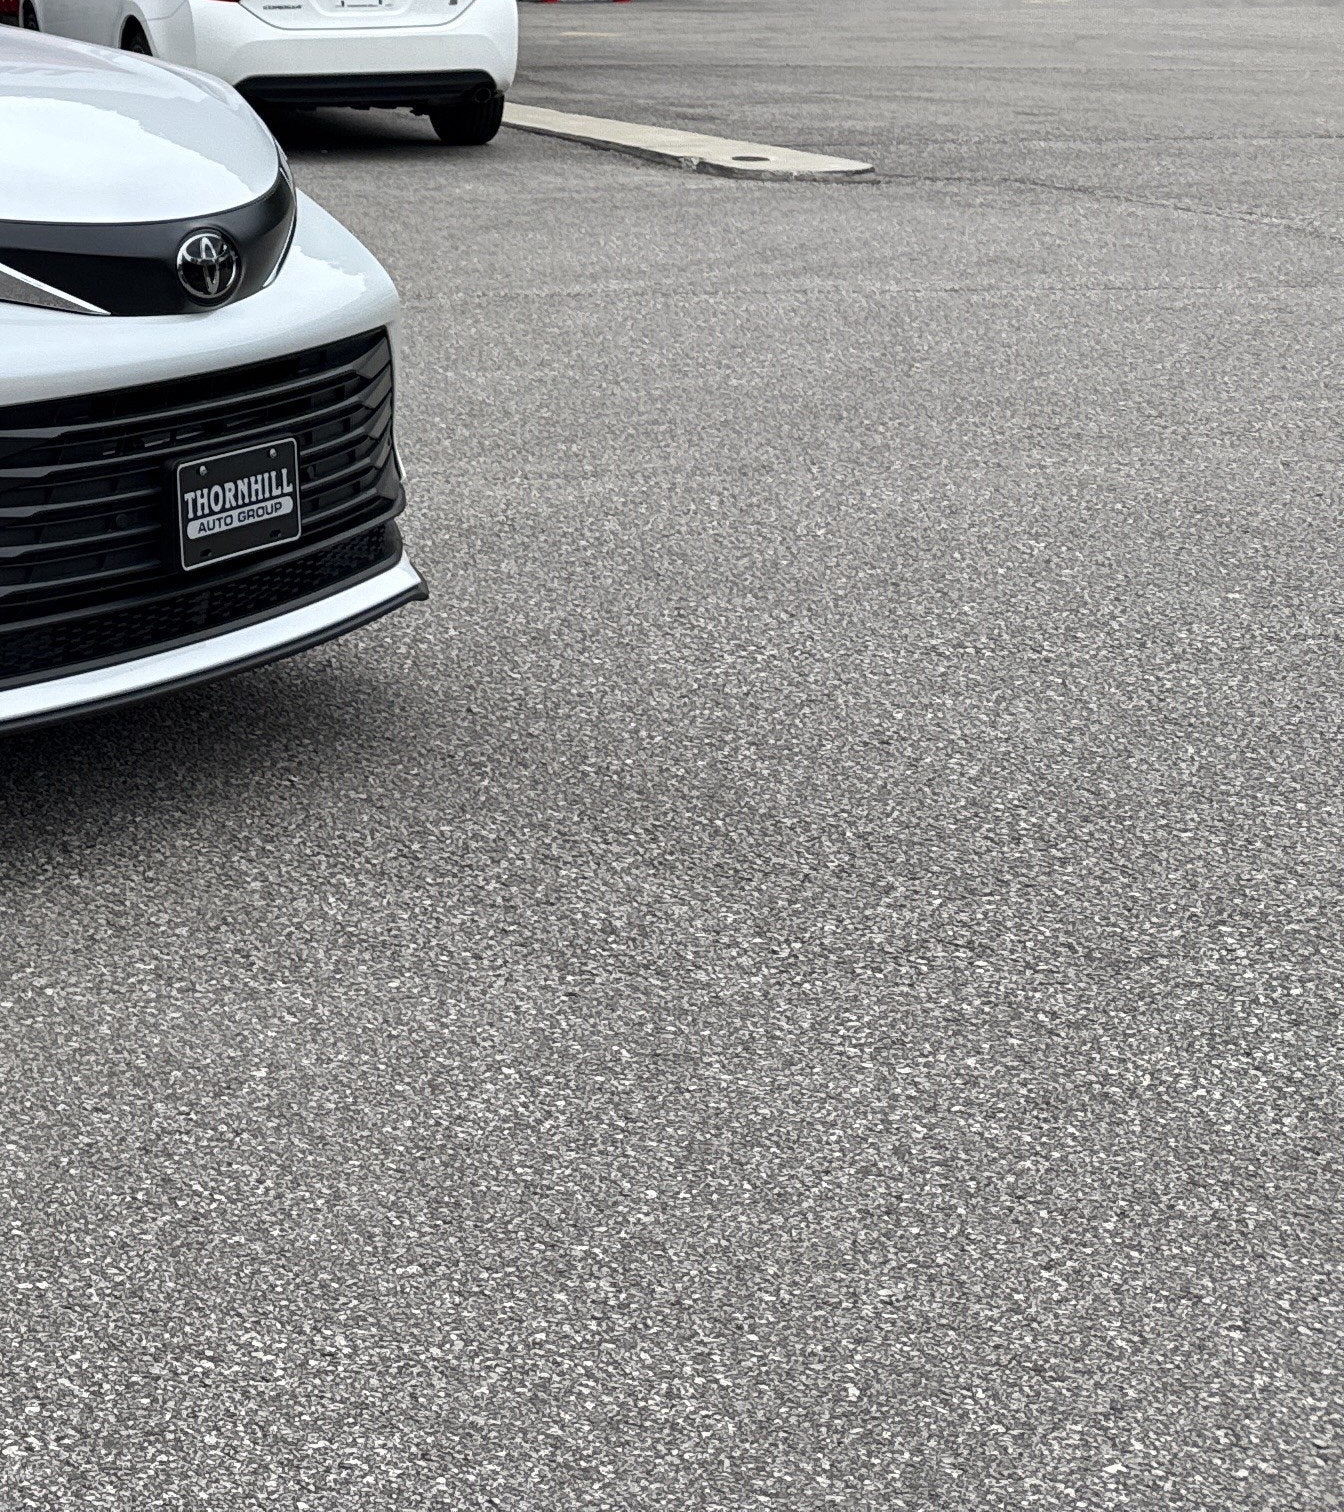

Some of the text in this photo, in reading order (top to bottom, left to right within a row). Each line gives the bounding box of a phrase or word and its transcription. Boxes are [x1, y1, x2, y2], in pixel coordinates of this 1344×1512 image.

[184, 468, 293, 519] THORNHILL
[197, 501, 283, 534] AUTO GROUP
